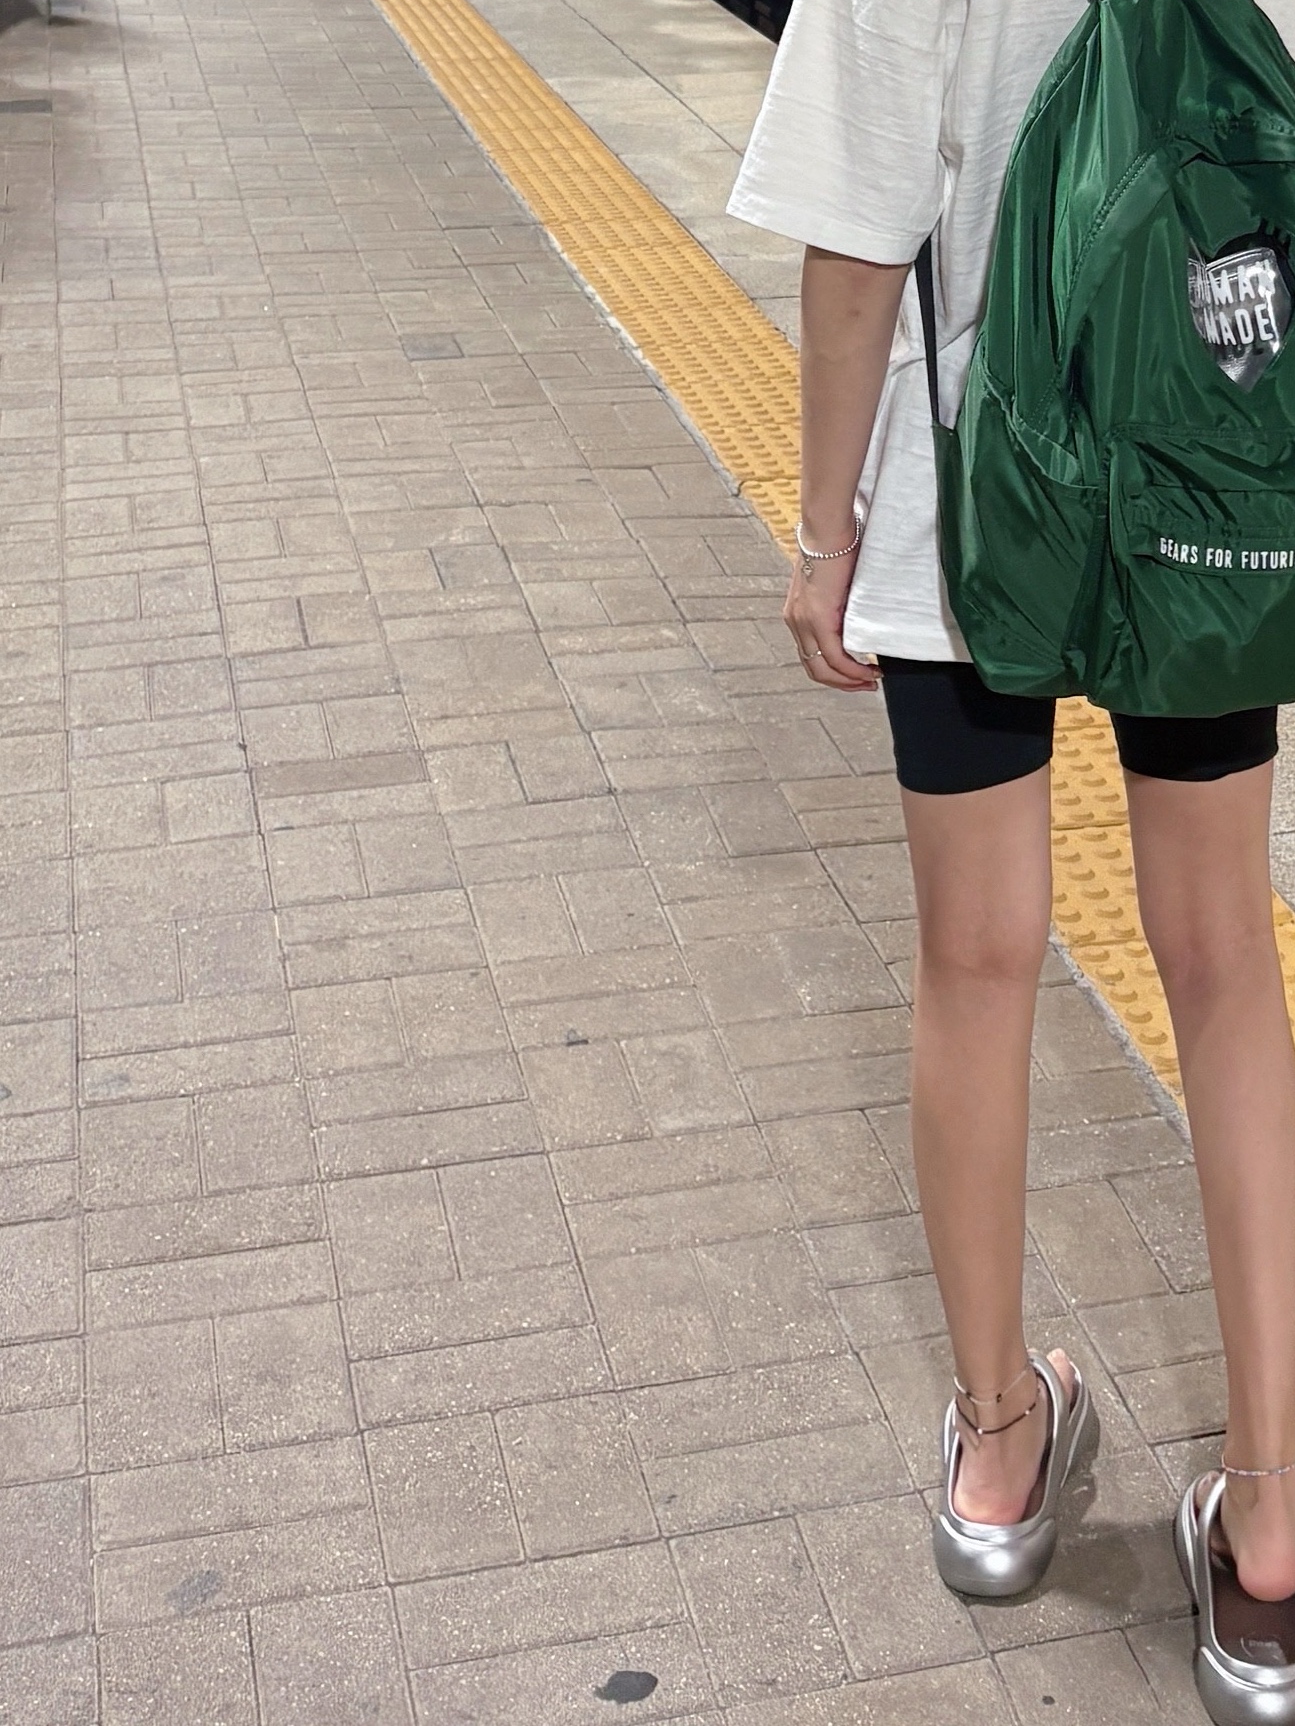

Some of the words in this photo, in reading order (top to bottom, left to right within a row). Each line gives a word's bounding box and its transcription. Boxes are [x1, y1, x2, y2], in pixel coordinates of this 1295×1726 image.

[1203, 303, 1274, 346] MADE
[1159, 537, 1199, 564] GEARS
[1205, 547, 1233, 569] FOR
